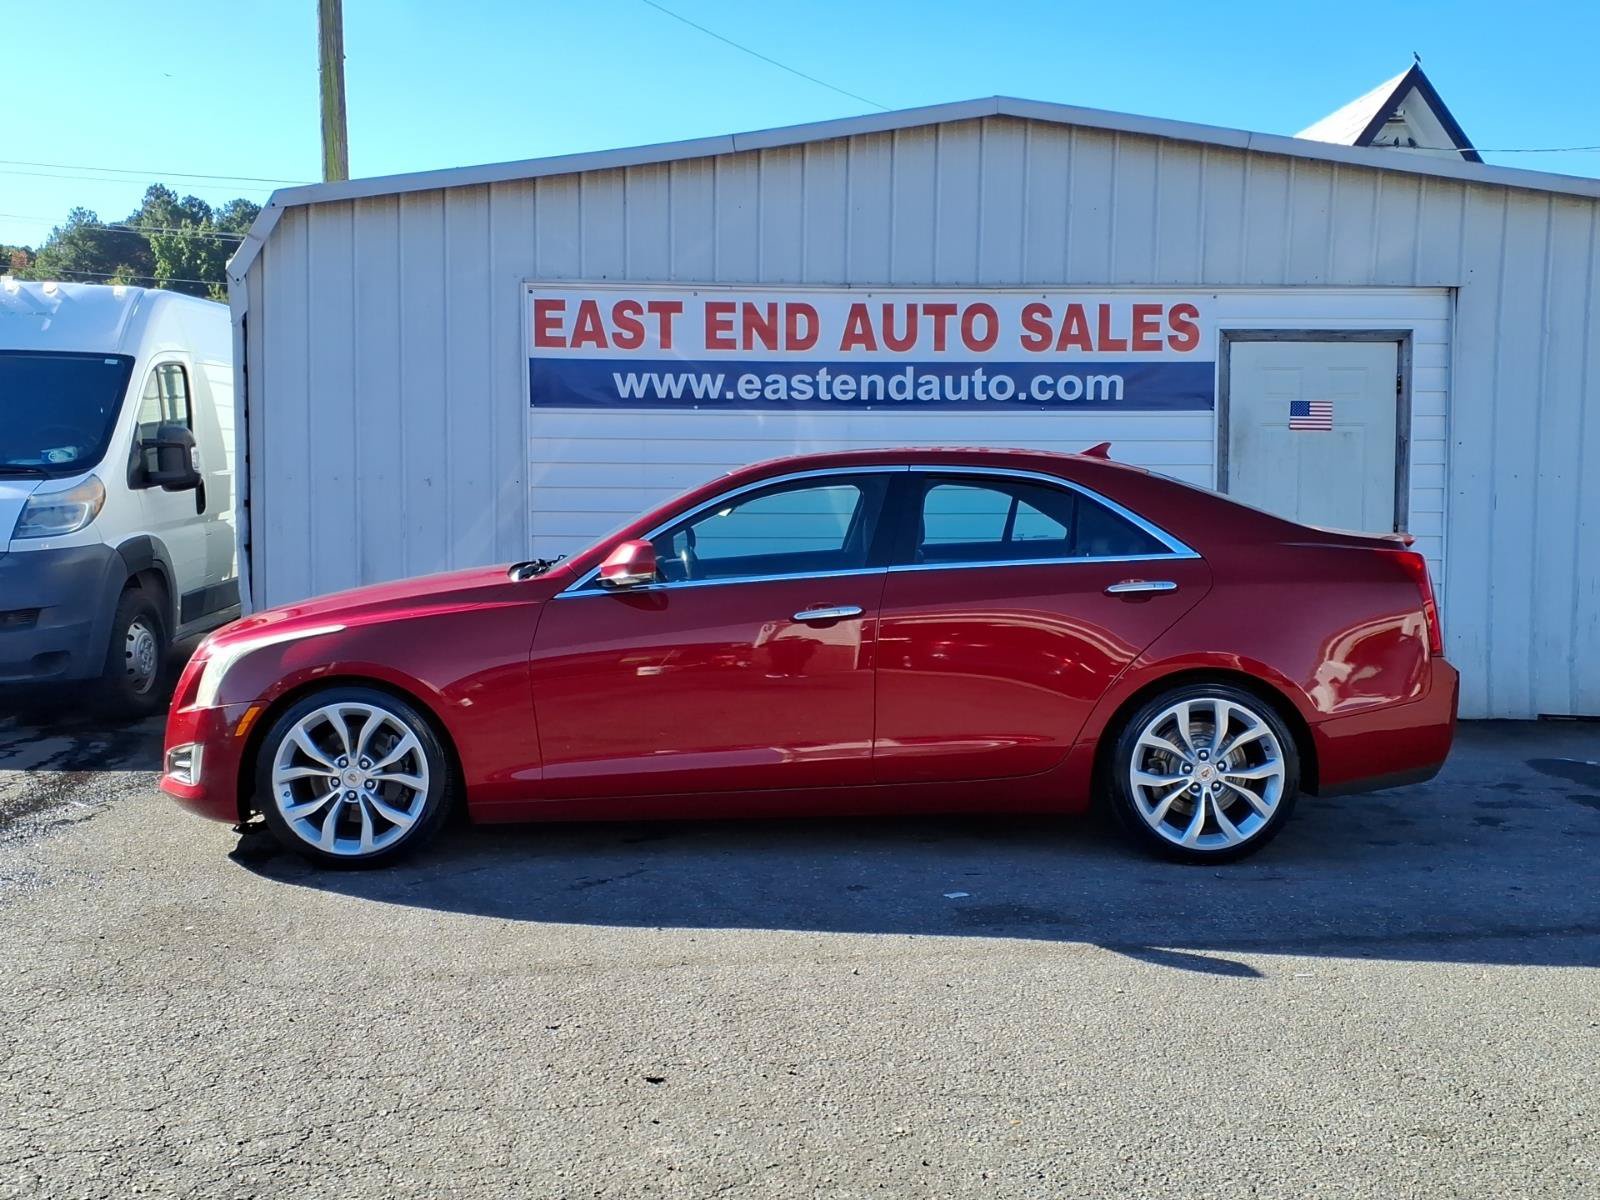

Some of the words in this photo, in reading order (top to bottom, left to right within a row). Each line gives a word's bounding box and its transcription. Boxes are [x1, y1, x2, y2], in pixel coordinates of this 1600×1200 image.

[533, 299, 683, 350] EAST
[705, 302, 820, 351] END
[840, 303, 999, 352] AUTO
[1020, 303, 1200, 353] SALES
[613, 366, 1125, 402] www.eastendauto.com
